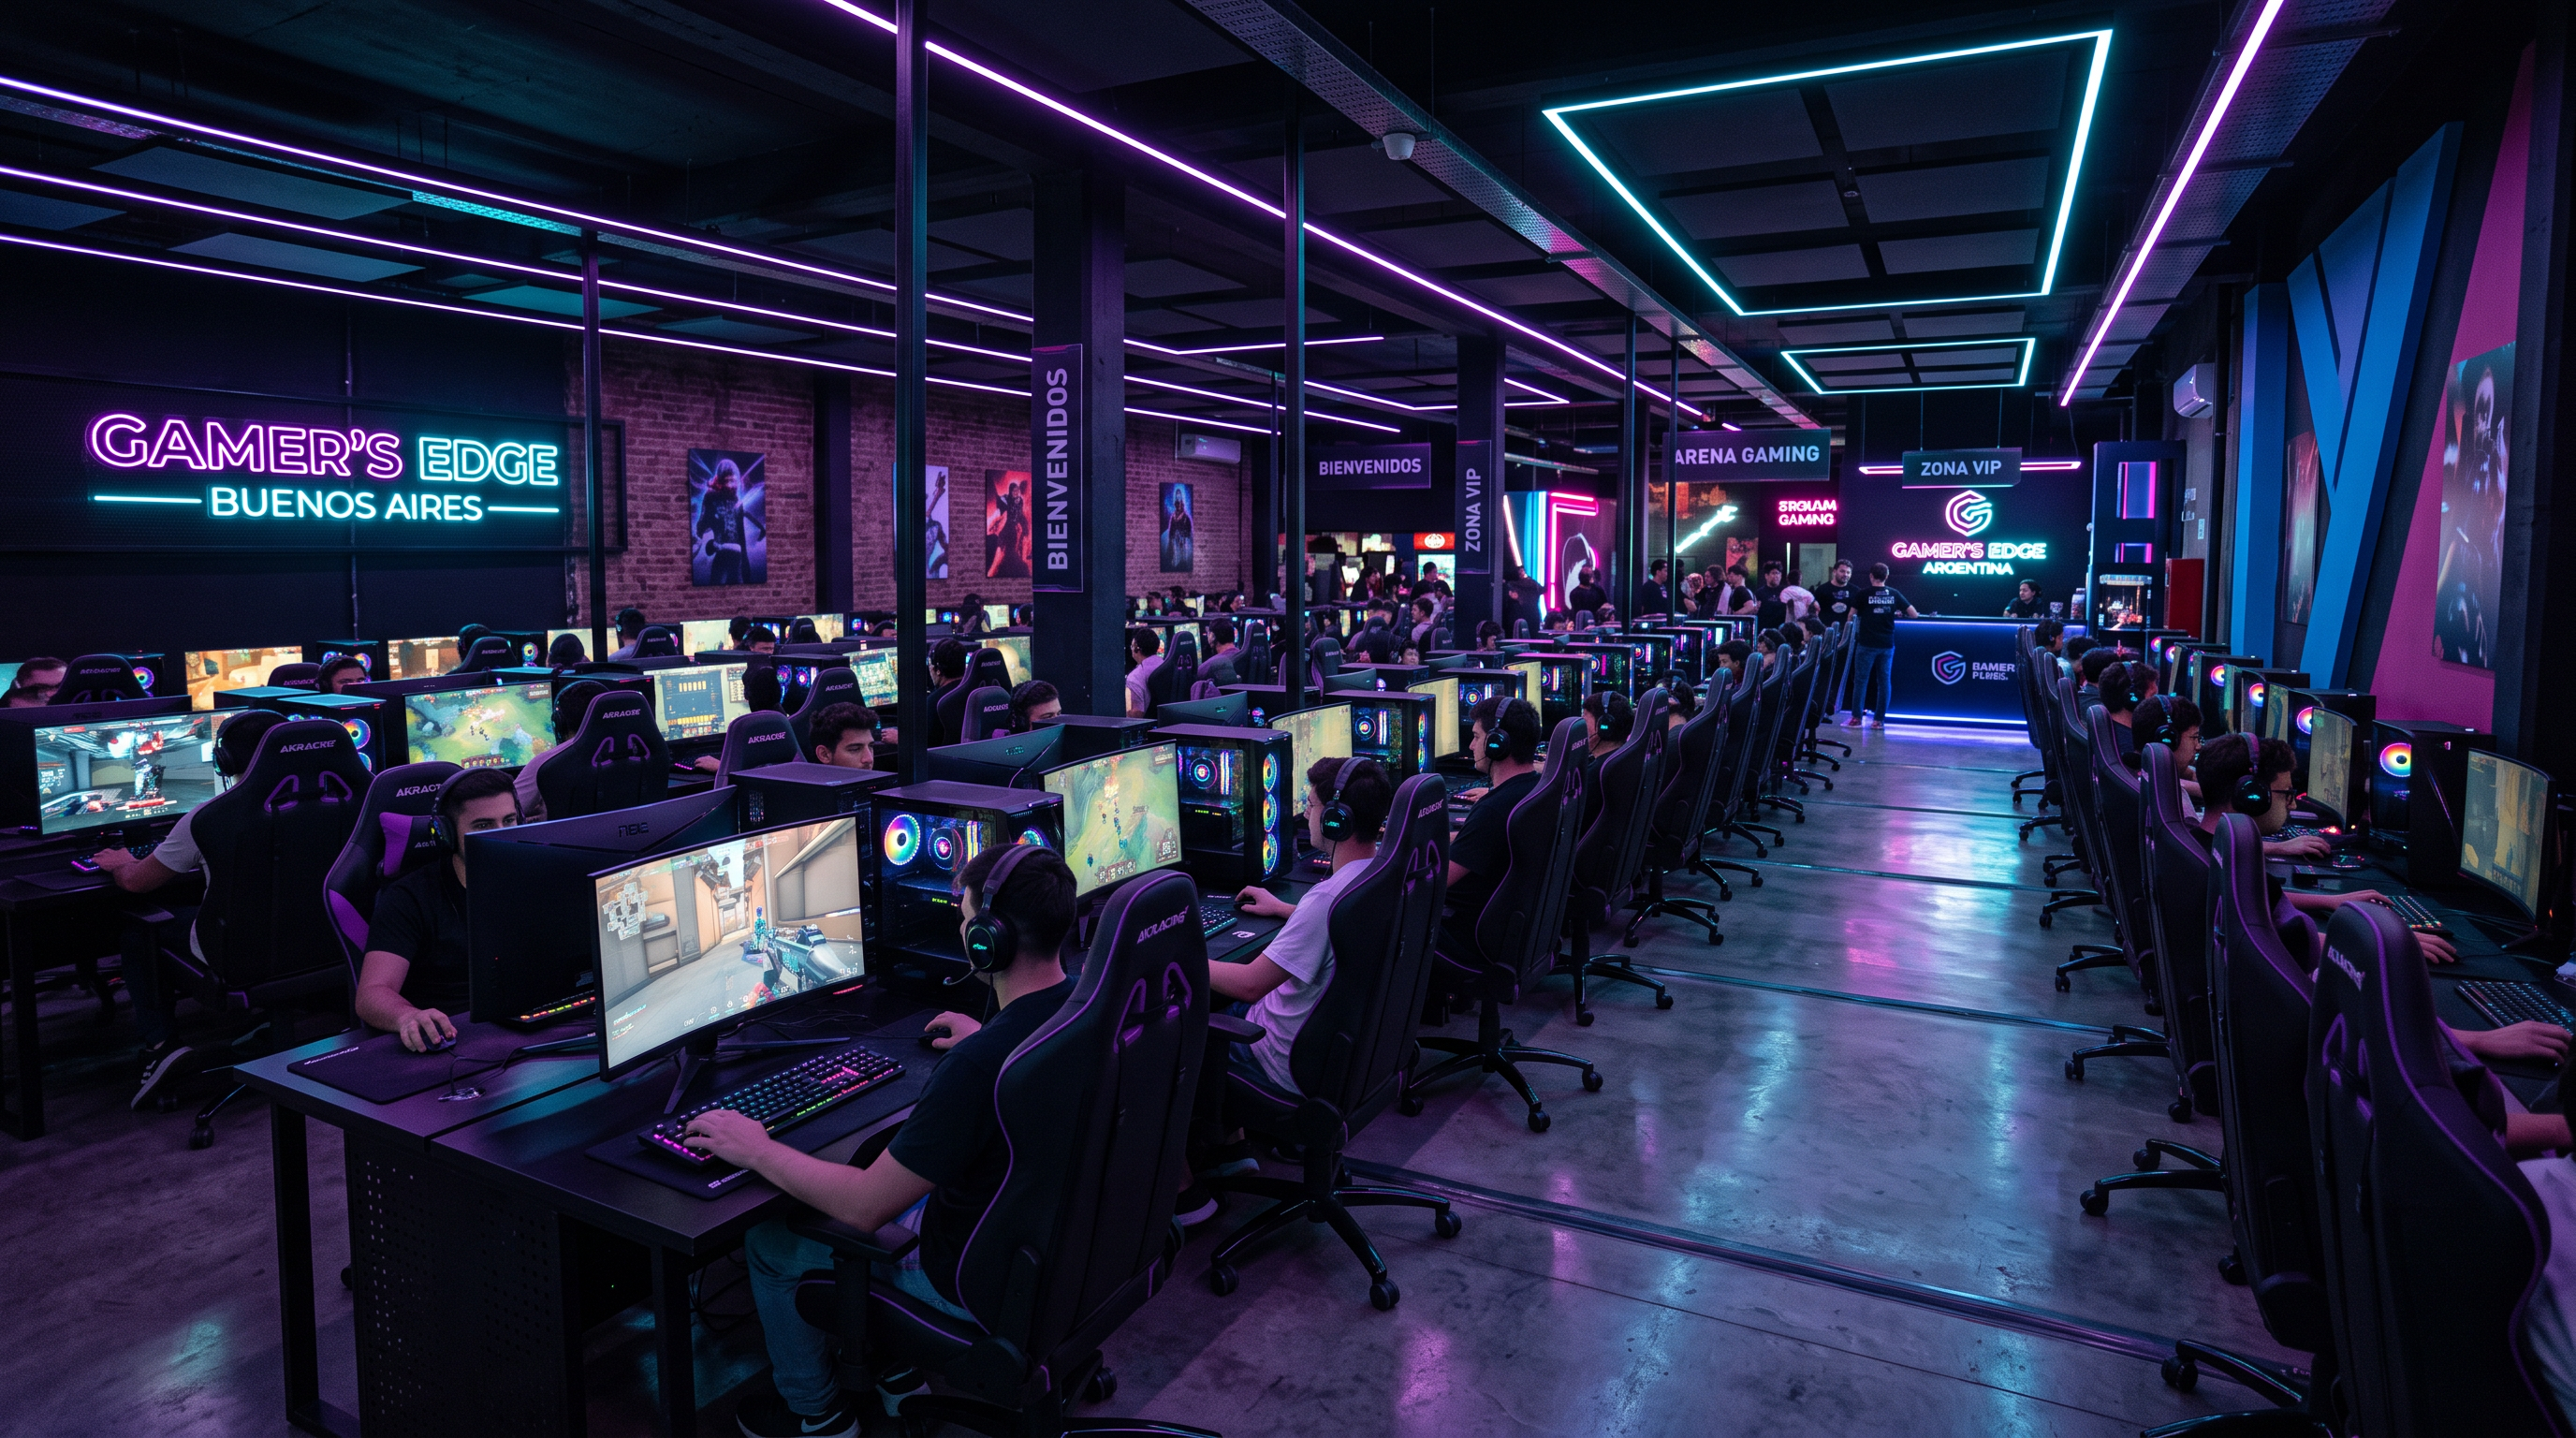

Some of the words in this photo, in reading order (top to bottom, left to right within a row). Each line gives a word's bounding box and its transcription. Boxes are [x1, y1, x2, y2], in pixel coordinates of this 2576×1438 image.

[92, 414, 403, 479] GAMER'S
[418, 436, 559, 486] EDGE
[1676, 448, 1737, 465] ARENA
[1741, 446, 1820, 463] GAMING
[1046, 368, 1068, 570] BIENVENIDOS
[1319, 458, 1422, 476] BIENVENIDOS
[1920, 462, 1969, 477] ZONA
[1972, 460, 2002, 476] VIP
[1465, 468, 1482, 499] VIP
[211, 486, 377, 520] BUENOS
[384, 492, 483, 521] AIRES
[1465, 502, 1482, 552] ZONA
[1778, 513, 1835, 526] GAMING
[1891, 541, 1984, 559] GAMER'S
[1987, 542, 2047, 560] EDGE
